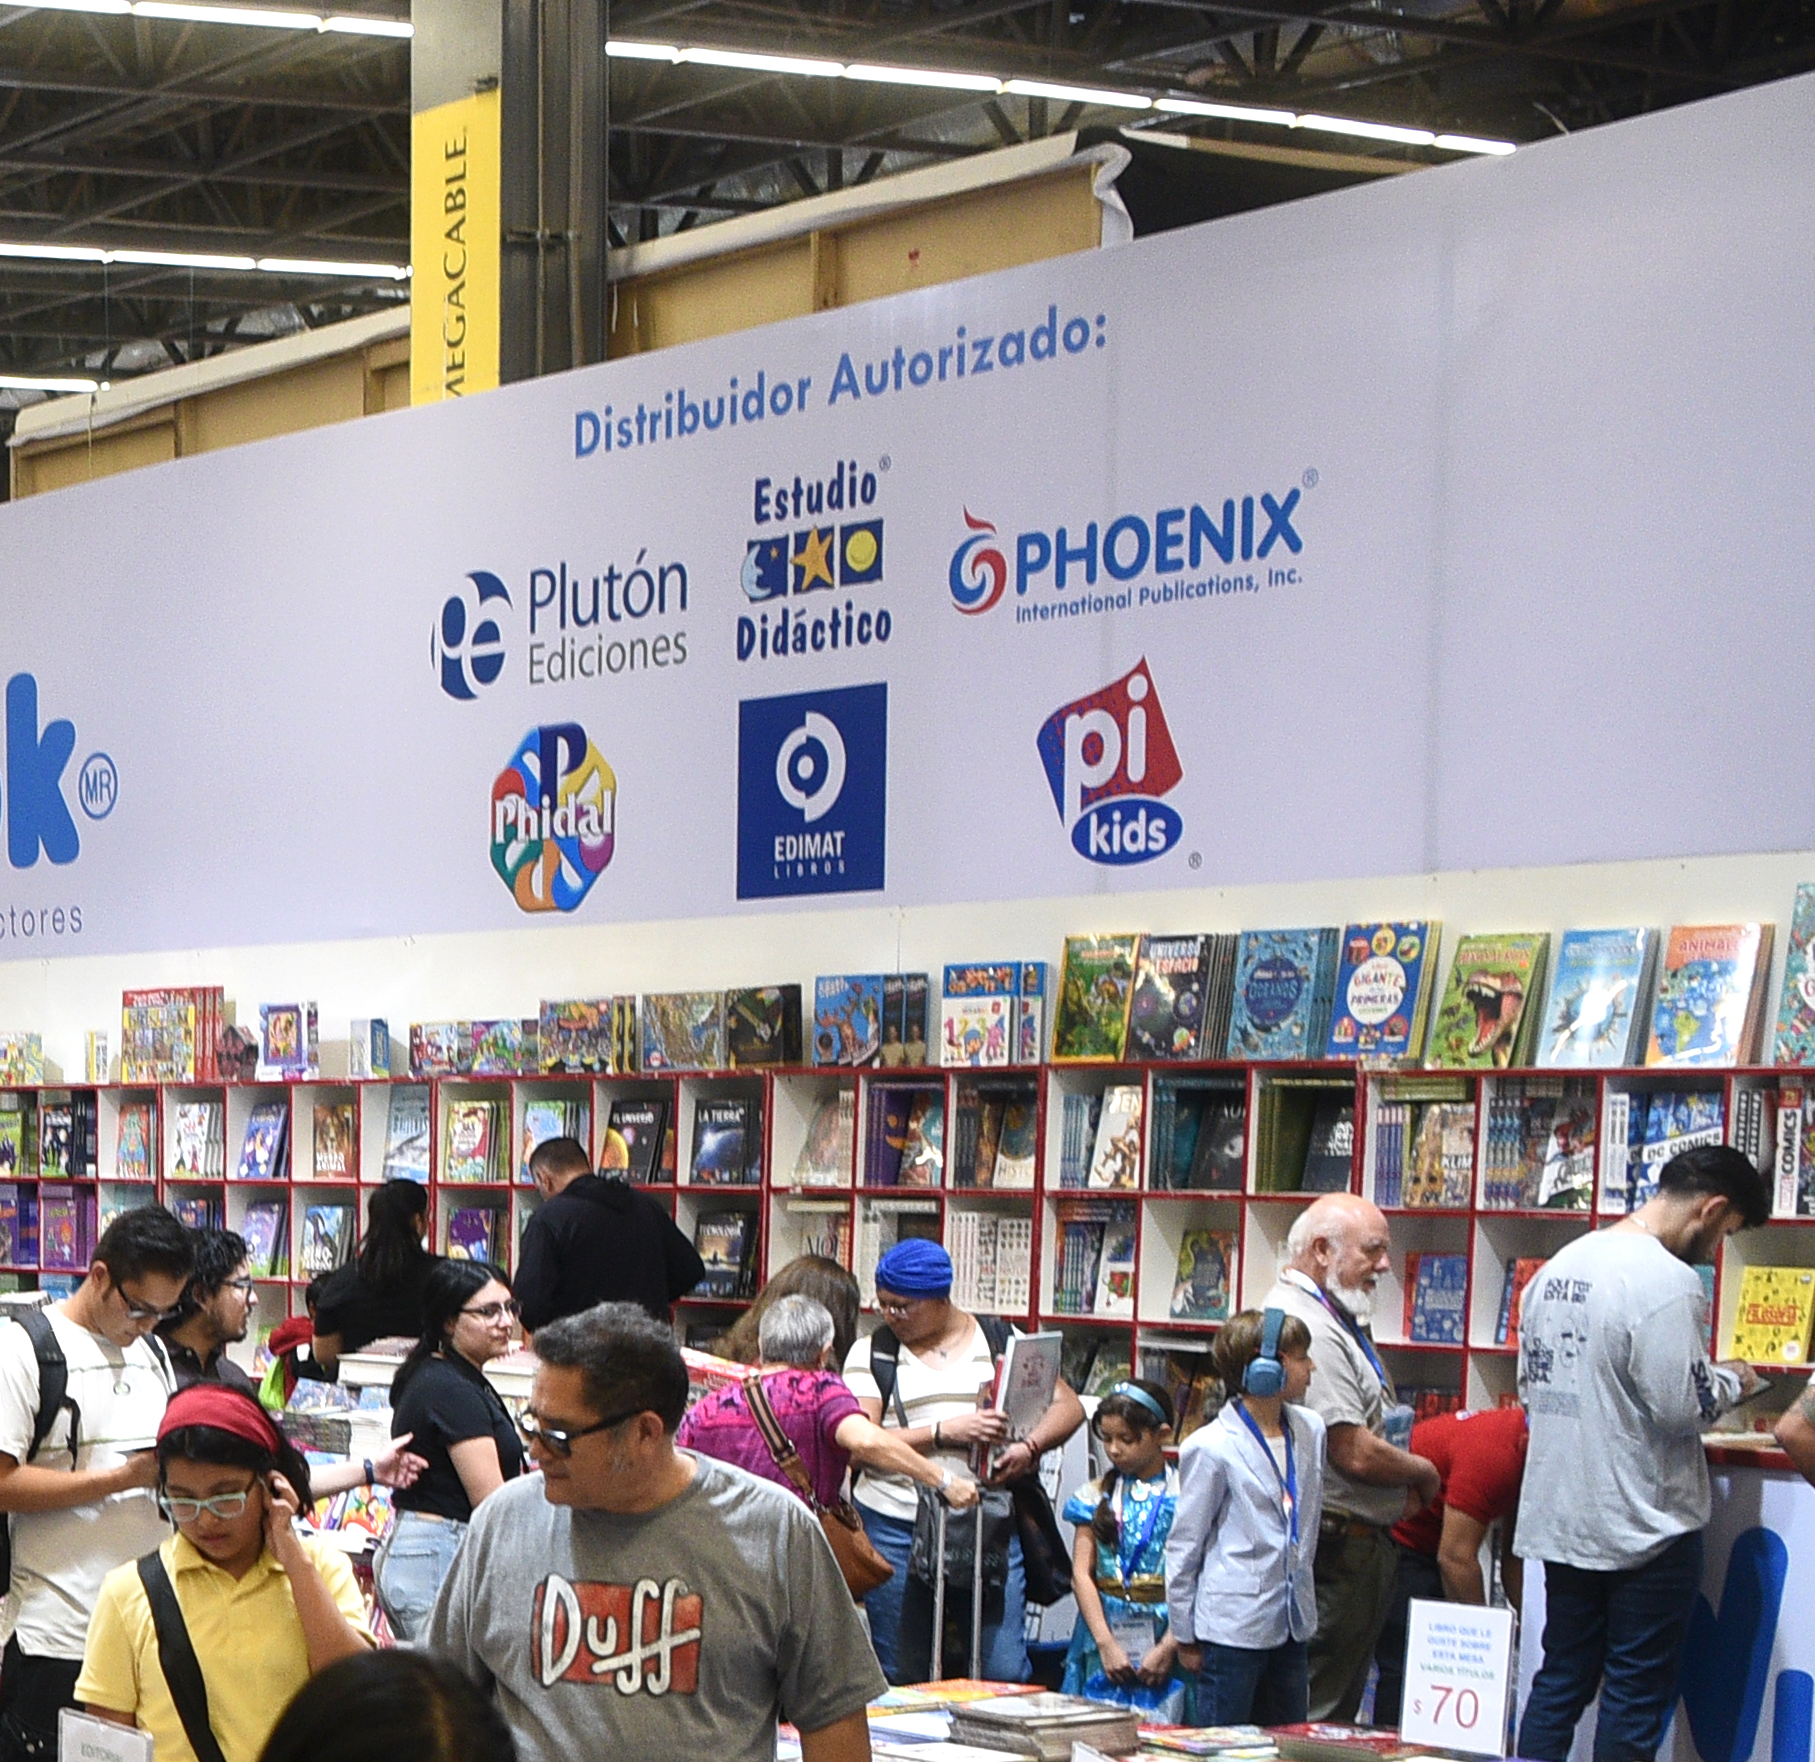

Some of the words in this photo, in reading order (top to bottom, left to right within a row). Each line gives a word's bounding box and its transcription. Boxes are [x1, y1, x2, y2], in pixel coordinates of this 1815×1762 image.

[574, 374, 812, 458] Distribuidor
[827, 307, 1107, 406] Autorizado:
[754, 461, 877, 523] Estudio
[1016, 486, 1302, 595] PHOENIX
[530, 547, 688, 636] Plutón
[1016, 588, 1132, 624] International
[1139, 574, 1260, 612] Publications,
[1268, 566, 1302, 591] Inc.
[736, 605, 892, 662] Didáctico
[529, 630, 688, 686] Ediciones
[1063, 671, 1149, 824] pi
[84, 768, 114, 804] MR
[494, 793, 613, 843] Phidal
[1090, 810, 1168, 857] kids
[774, 830, 845, 863] EDIMAT
[774, 859, 845, 879] LIBROS
[698, 1109, 710, 1123] LA
[711, 1108, 741, 1123] TIERRA
[1442, 1154, 1472, 1171] KLIM
[1647, 1145, 1664, 1160] DC
[1670, 1132, 1720, 1155] COMICS
[1781, 1110, 1798, 1175] COMICS
[542, 1574, 700, 1696] Duff
[1427, 1636, 1458, 1647] GUSTE
[1460, 1639, 1491, 1650] SOBRE
[1429, 1623, 1457, 1635] LIBRO
[1458, 1625, 1478, 1636] QUE
[1480, 1627, 1491, 1638] LE
[1420, 1662, 1455, 1675] VARIOS
[1432, 1650, 1456, 1660] ESTA
[1459, 1652, 1484, 1664] MESA
